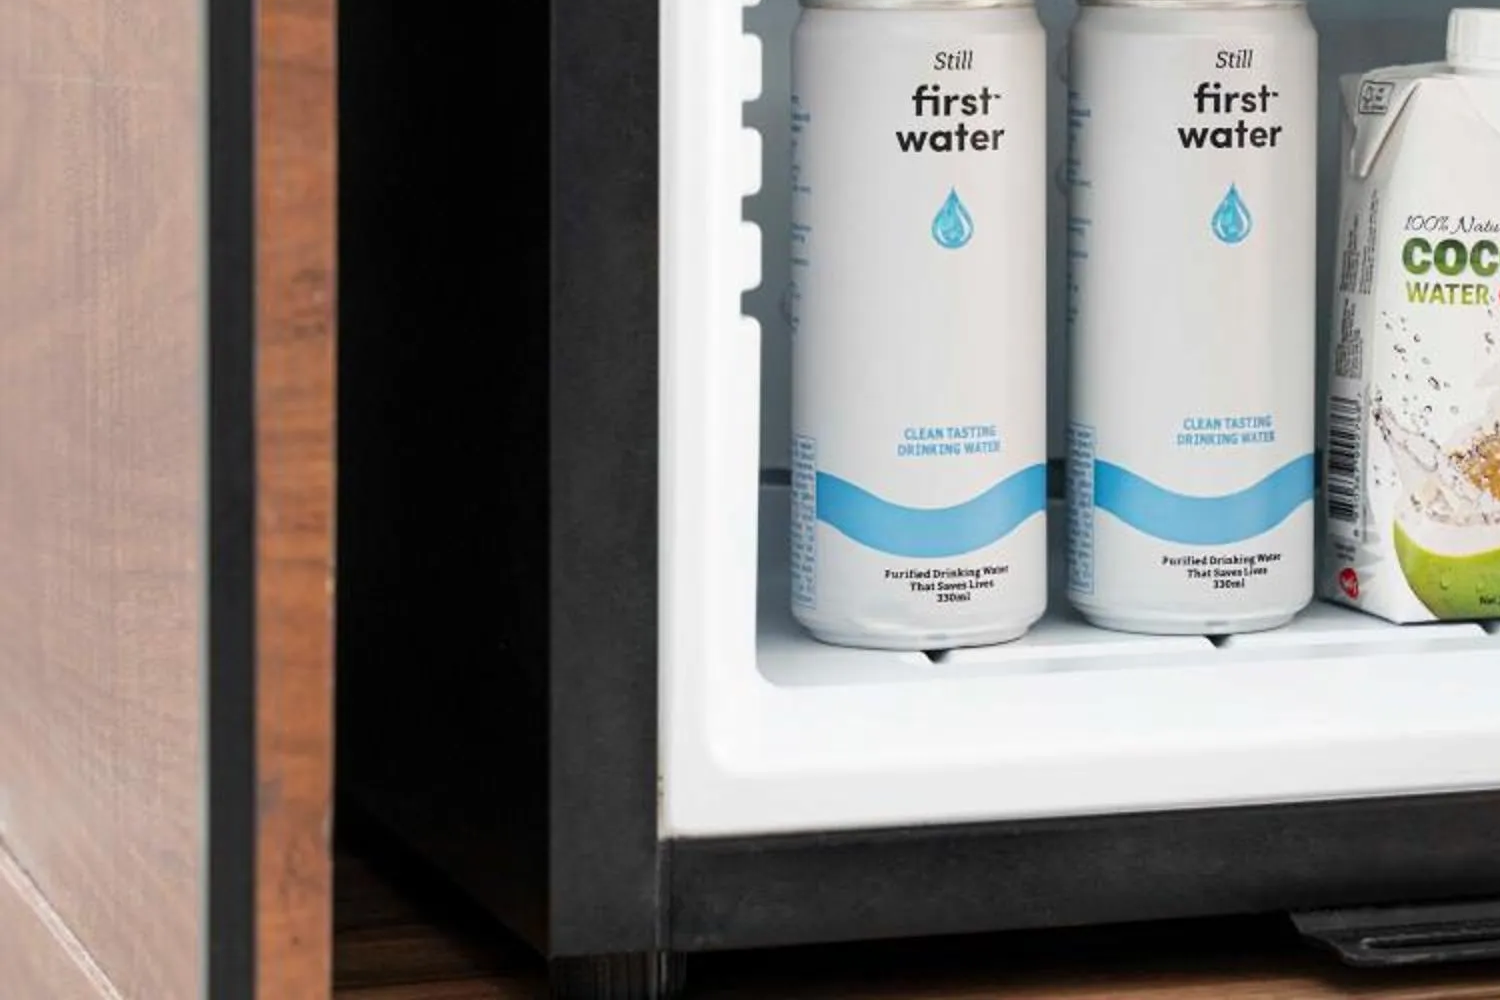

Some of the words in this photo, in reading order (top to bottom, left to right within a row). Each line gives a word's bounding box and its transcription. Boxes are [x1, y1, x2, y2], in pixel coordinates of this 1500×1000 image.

[934, 50, 973, 71] Still
[1215, 50, 1253, 69] Still
[912, 84, 994, 117] first
[1194, 82, 1271, 113] first
[896, 123, 1005, 152] water
[1178, 120, 1282, 149] water
[1404, 215, 1450, 233] 100%
[1406, 282, 1489, 306] WATER
[1183, 417, 1221, 430] CLEAN
[1224, 415, 1272, 428] TASTING
[904, 427, 944, 441] CLEAN
[948, 425, 997, 440] TASTING
[1177, 433, 1239, 446] DRINKING
[1242, 431, 1275, 443] WATER
[897, 443, 961, 457] DRINKING
[964, 440, 1001, 454] WATER
[1162, 556, 1207, 566] Purified
[1209, 555, 1256, 567] Drinking
[884, 568, 931, 580] Purified
[932, 567, 981, 580] Drinking
[1187, 568, 1211, 578] That
[1213, 568, 1242, 577] Saves
[910, 581, 935, 592] That
[937, 581, 967, 591] Saves
[969, 579, 994, 589] Lives
[936, 592, 971, 603] 330ml
